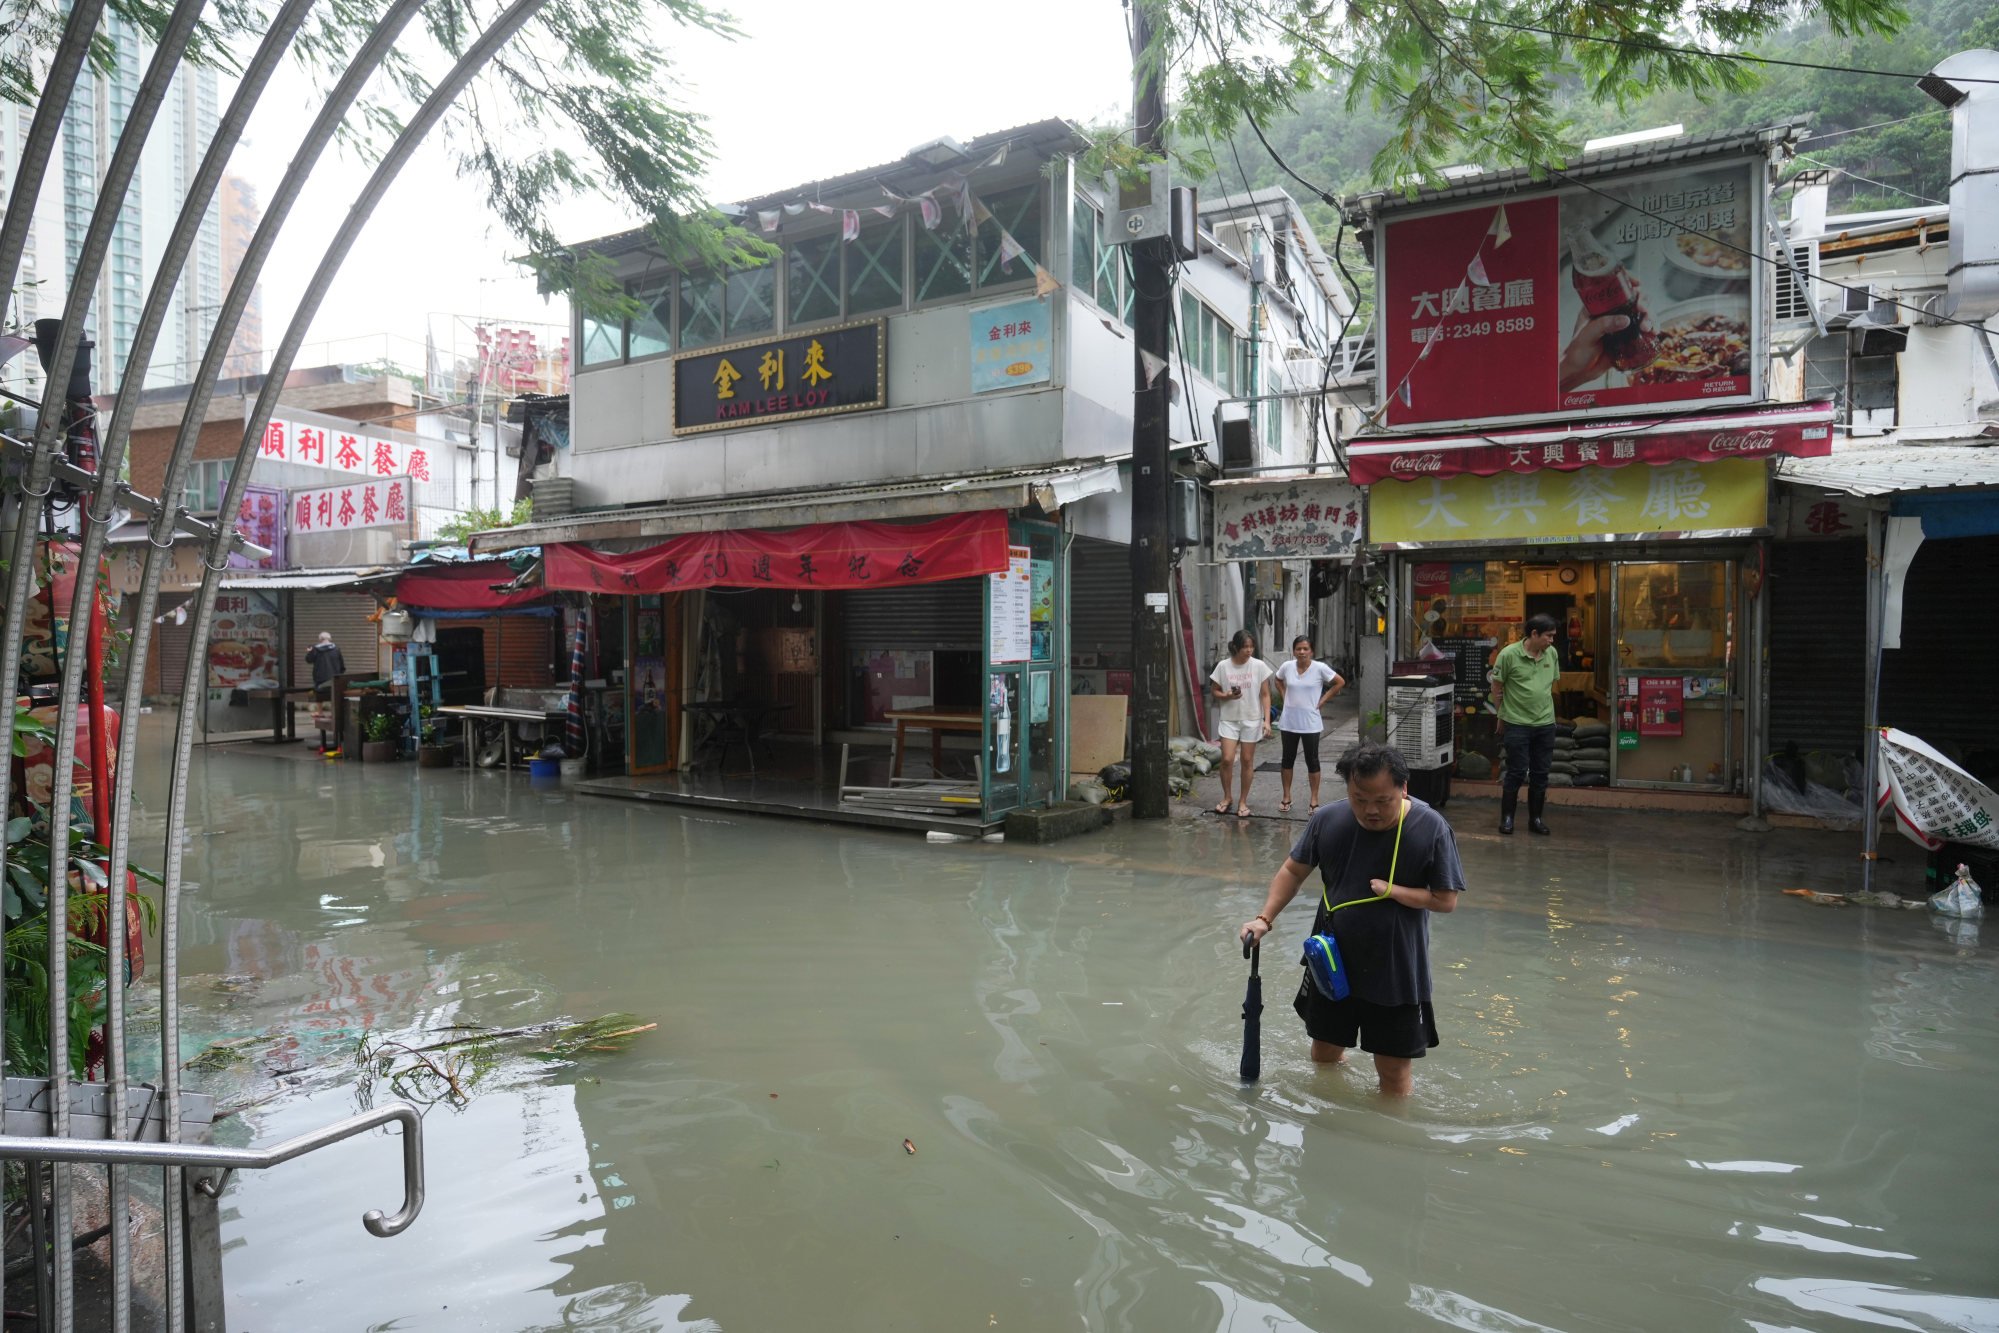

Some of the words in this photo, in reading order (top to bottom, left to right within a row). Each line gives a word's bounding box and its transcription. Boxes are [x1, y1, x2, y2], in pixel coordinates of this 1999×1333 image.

[988, 320, 1032, 341] 金利來
[1495, 316, 1535, 334] 8589
[712, 339, 833, 399] 金利來
[1704, 380, 1734, 388] RETURN
[1713, 385, 1737, 393] REUSE
[716, 403, 751, 419] KAM
[756, 395, 789, 413] LEE
[795, 390, 829, 408] LOY
[1564, 393, 1596, 406] Coca-Cola
[261, 421, 430, 482] 順利茶餐廳
[1510, 438, 1636, 466] 大興餐廳
[1708, 429, 1778, 452] Coca-Cola
[1390, 453, 1445, 473] Coca-Cola
[294, 482, 405, 530] 順利茶餐廳
[1413, 463, 1711, 530] 大興餐廳
